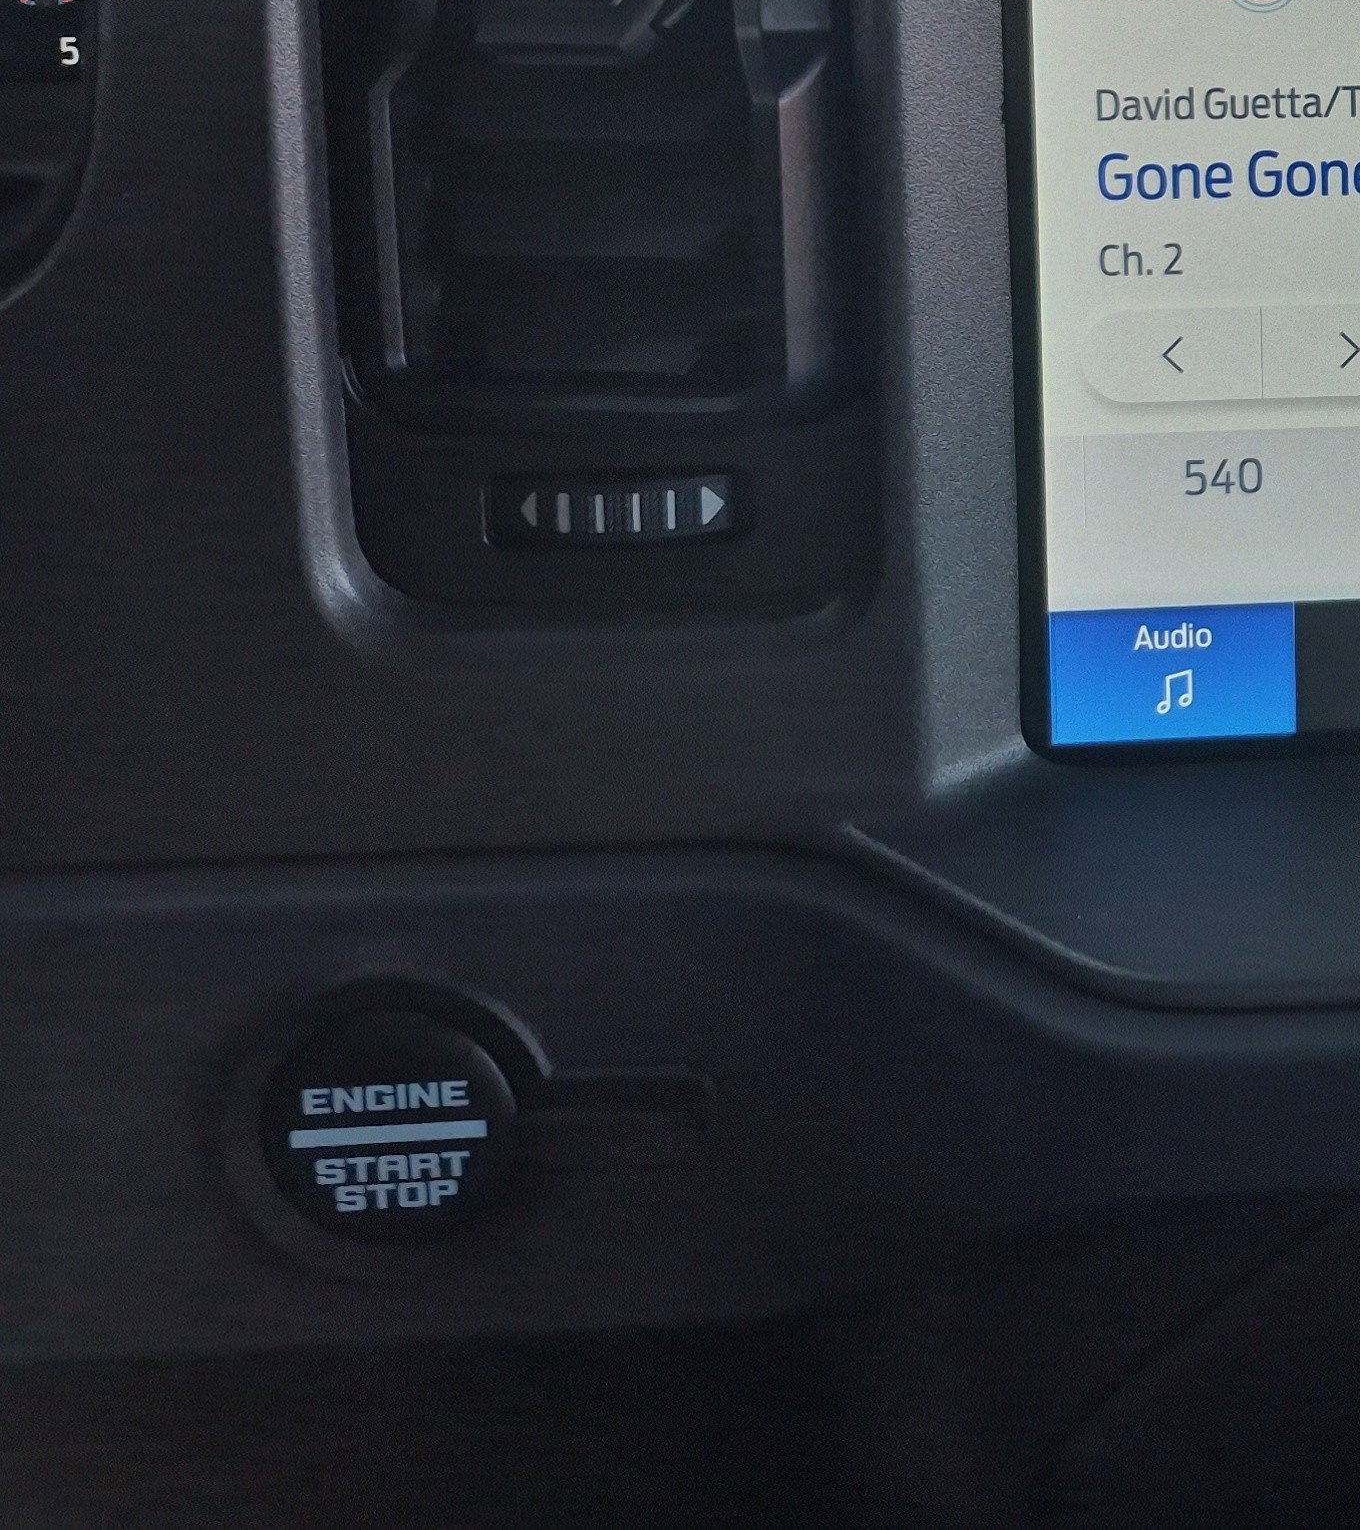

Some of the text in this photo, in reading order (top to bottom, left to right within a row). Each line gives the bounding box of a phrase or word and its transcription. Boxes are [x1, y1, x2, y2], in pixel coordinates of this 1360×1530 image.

[60, 37, 79, 65] 5
[1096, 86, 1195, 122] David
[1097, 152, 1233, 201] Gone
[1098, 242, 1183, 277] Ch. 2
[1184, 457, 1263, 497] 540
[1133, 622, 1212, 651] Audio
[302, 1080, 470, 1115] ENGINE
[315, 1150, 470, 1185] START
[336, 1179, 459, 1212] STOP
